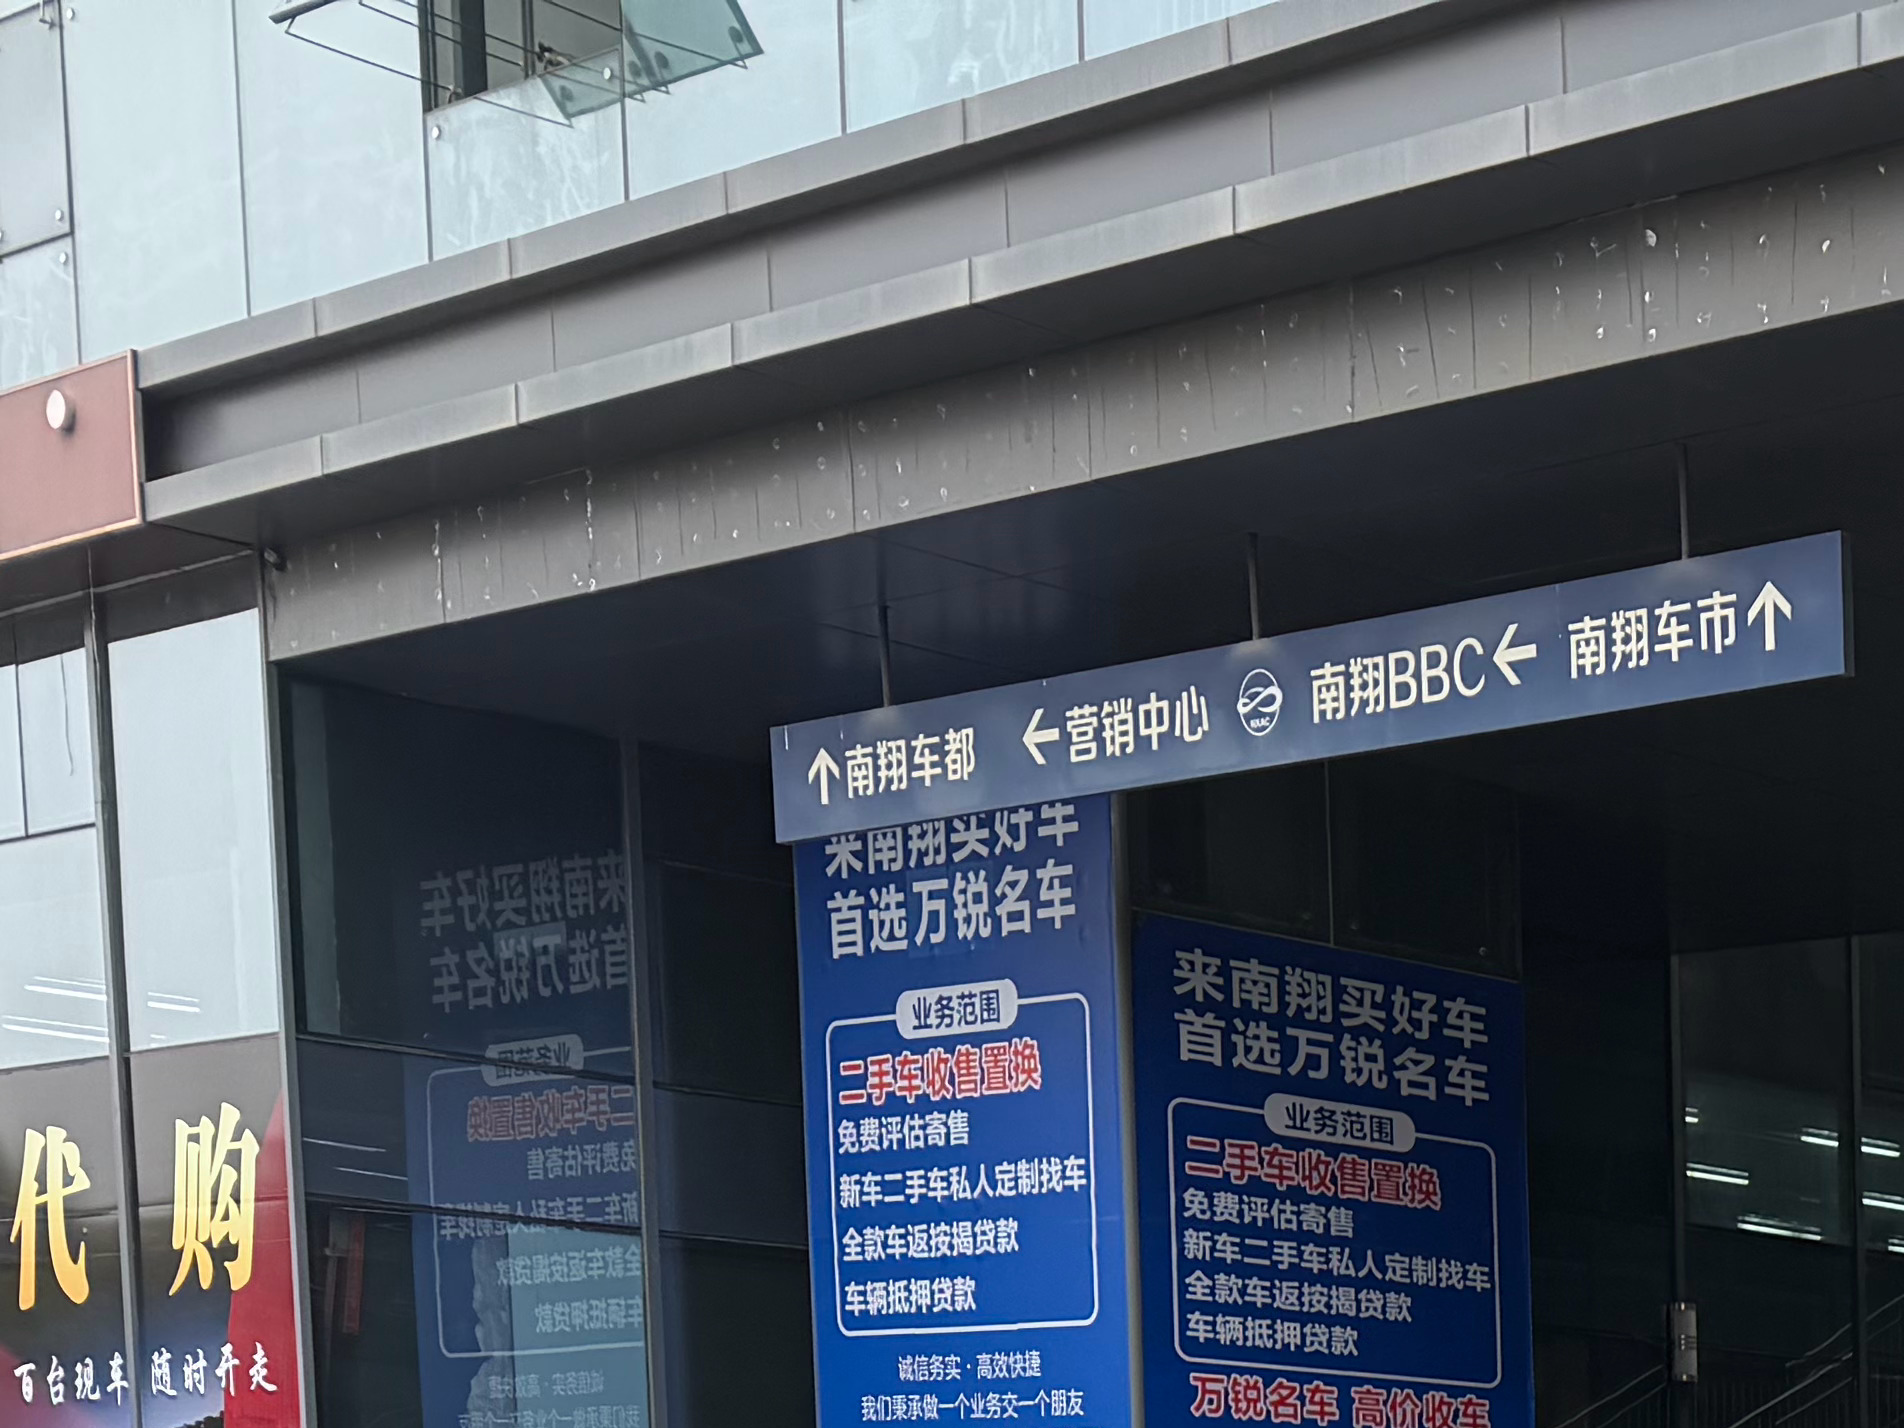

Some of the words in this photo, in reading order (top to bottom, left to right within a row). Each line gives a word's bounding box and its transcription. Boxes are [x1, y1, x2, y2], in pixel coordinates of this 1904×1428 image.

[1568, 592, 1738, 679] 南翔车市
[1310, 637, 1487, 724] 南翔BBC
[1065, 686, 1209, 764] 营销中心
[845, 727, 975, 799] 南翔车都
[827, 859, 1076, 959] 首选万锐名车
[912, 989, 1000, 1030] 业务范围
[1173, 947, 1489, 1050] 来南翔买好车
[839, 1037, 1041, 1106] 二手车收售置换
[1174, 1008, 1490, 1106] 首选万锐名车
[838, 1110, 970, 1154] 免费评估寄售
[1284, 1102, 1394, 1145] 业务范围
[839, 1157, 1087, 1208] 新车二手车私人定制找车
[1185, 1134, 1441, 1211] 二手车收售置换
[842, 1219, 1019, 1262] 全款车返按揭贷款
[1182, 1188, 1355, 1239] 免费评估寄售
[1182, 1228, 1492, 1293] 新车二手车私人定制找车
[844, 1277, 976, 1317] 车辆抵押贷款
[1184, 1270, 1413, 1324] 全款车返按揭贷款
[1185, 1312, 1359, 1357] 车辆抵押贷款
[13, 1351, 129, 1406] 百台现车
[150, 1341, 279, 1400] 随时开走
[1189, 1372, 1340, 1427] 万锐名车
